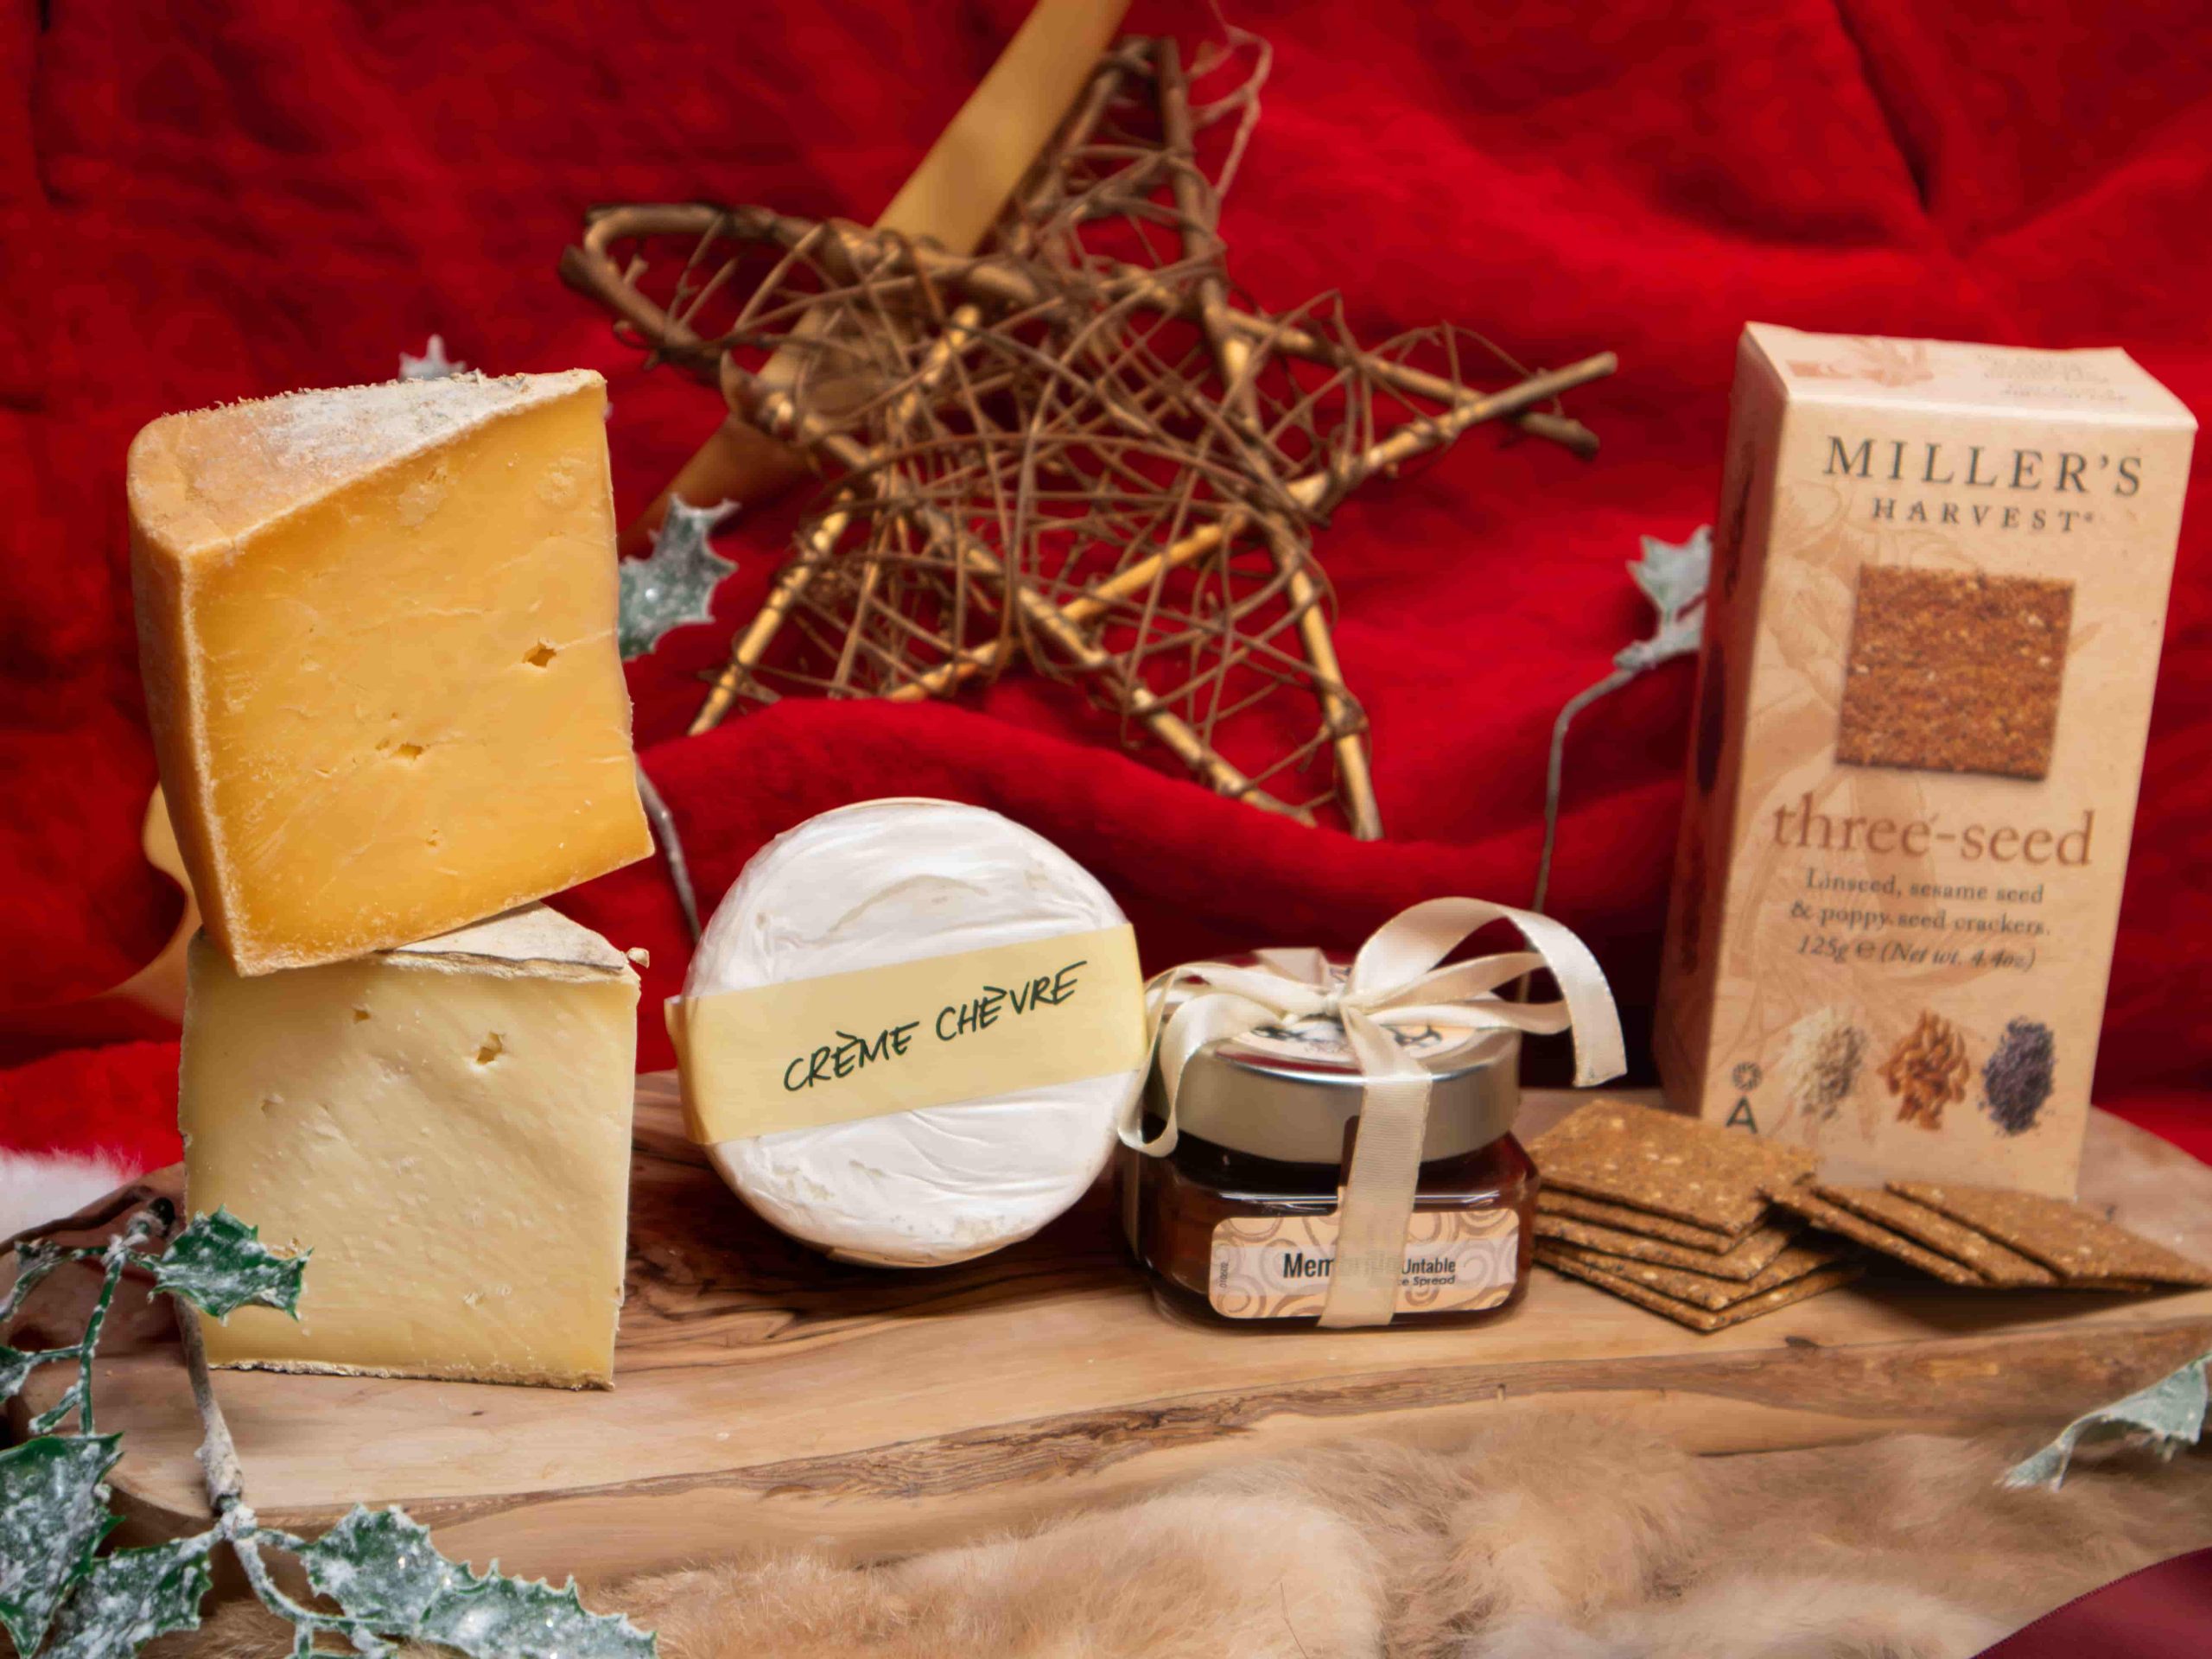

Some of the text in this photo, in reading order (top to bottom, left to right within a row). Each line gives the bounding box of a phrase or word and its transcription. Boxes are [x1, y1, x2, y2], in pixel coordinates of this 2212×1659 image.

[1822, 435, 2143, 499] MILLER'S
[1772, 791, 2095, 867] three-seed
[1790, 899, 1811, 921] &
[1820, 907, 1890, 931] poppy
[1897, 908, 1946, 930] seed
[1910, 882, 1988, 900] sesame
[1996, 882, 2044, 904] seed
[783, 960, 1088, 1092] CRÈME CHÈVRE
[1413, 1274, 1456, 1287] Spread
